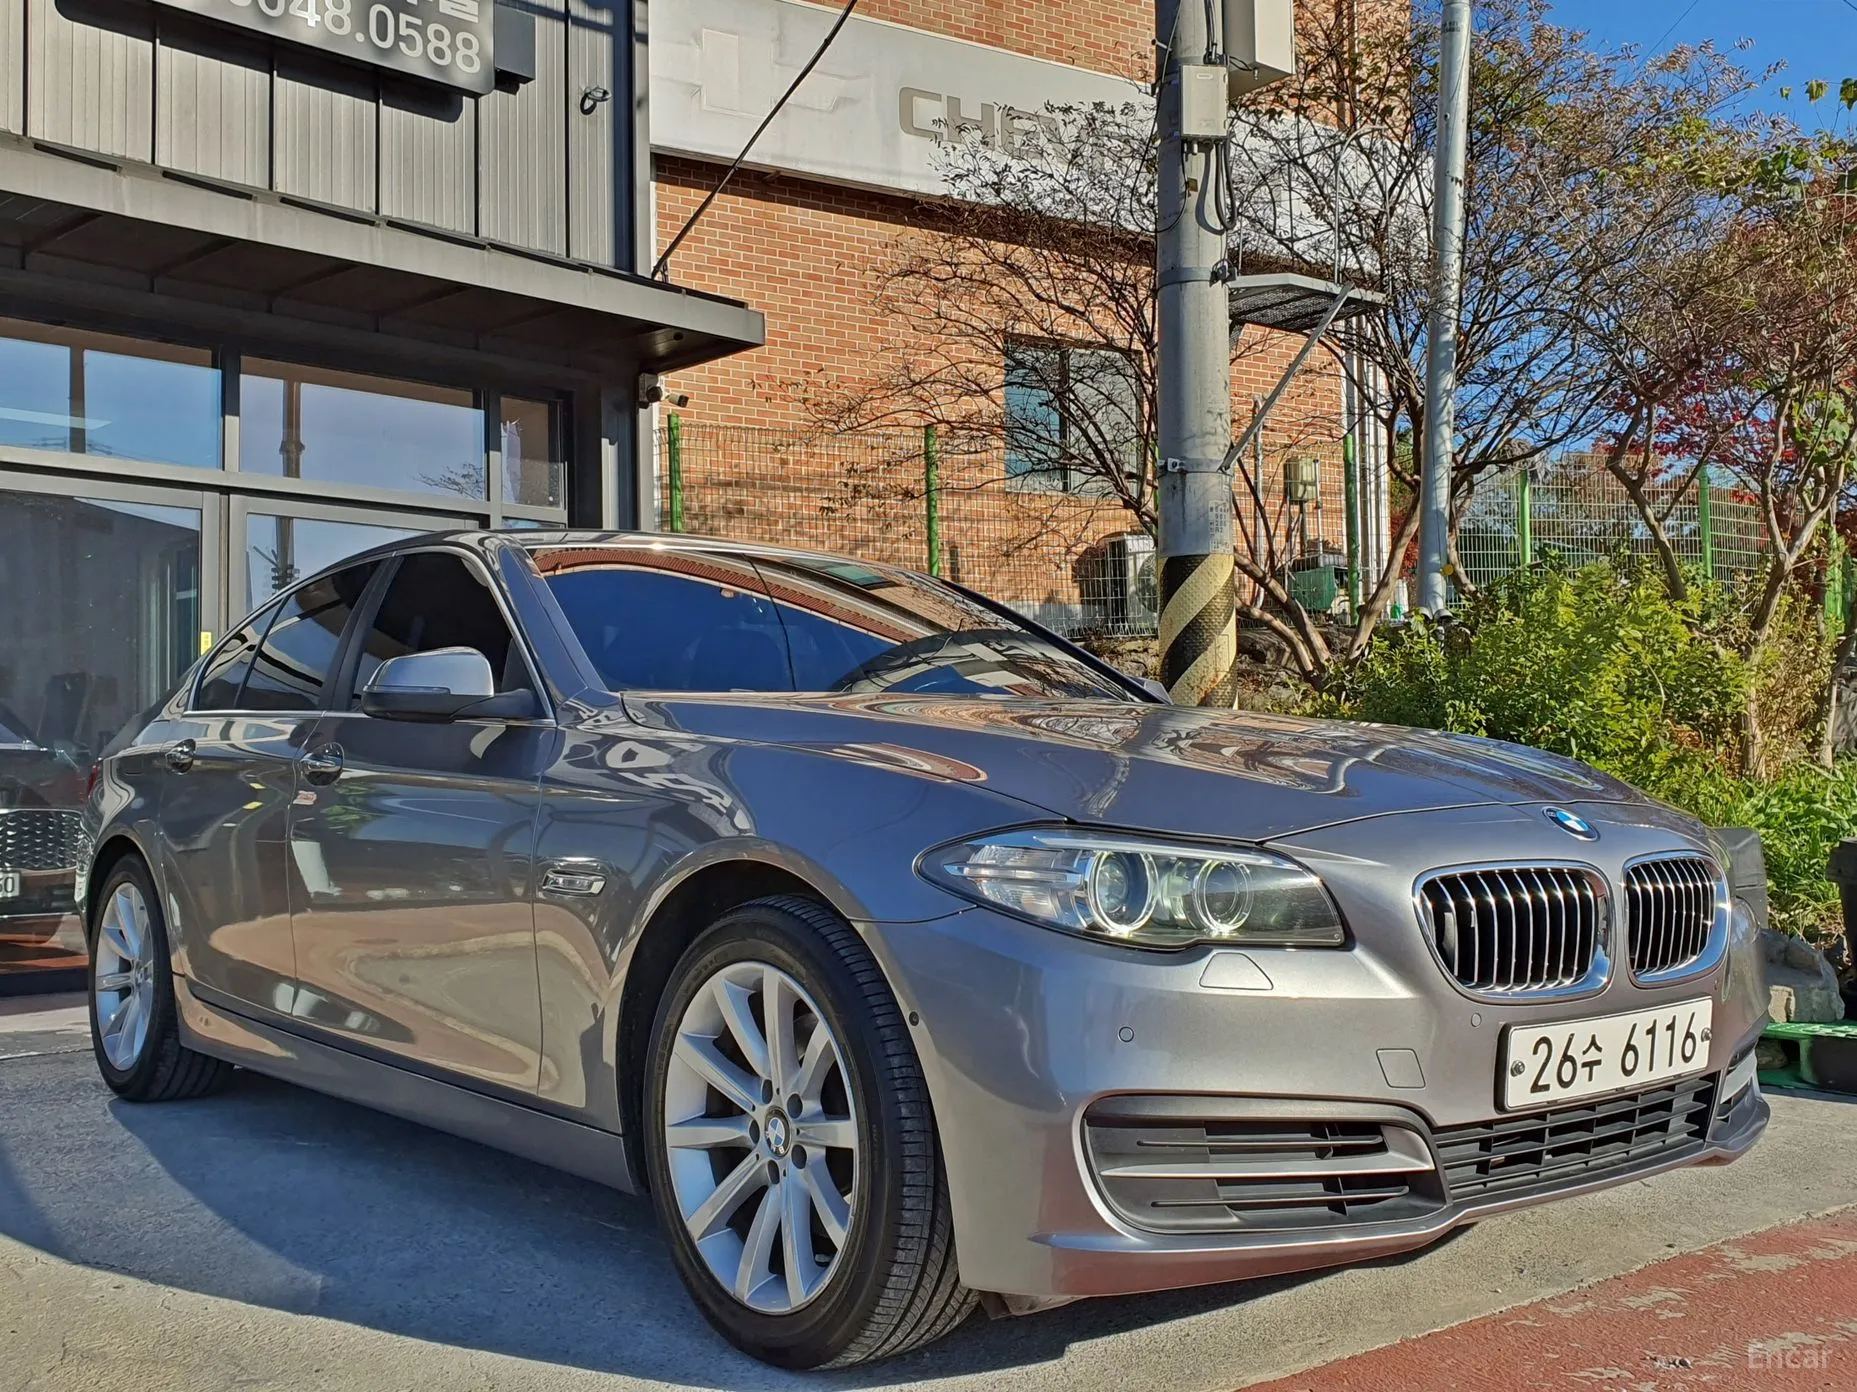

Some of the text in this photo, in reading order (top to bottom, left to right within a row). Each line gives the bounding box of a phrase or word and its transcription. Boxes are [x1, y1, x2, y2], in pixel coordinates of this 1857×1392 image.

[229, 0, 481, 74] 48.0588
[1530, 1012, 1697, 1094] 26수 6116
